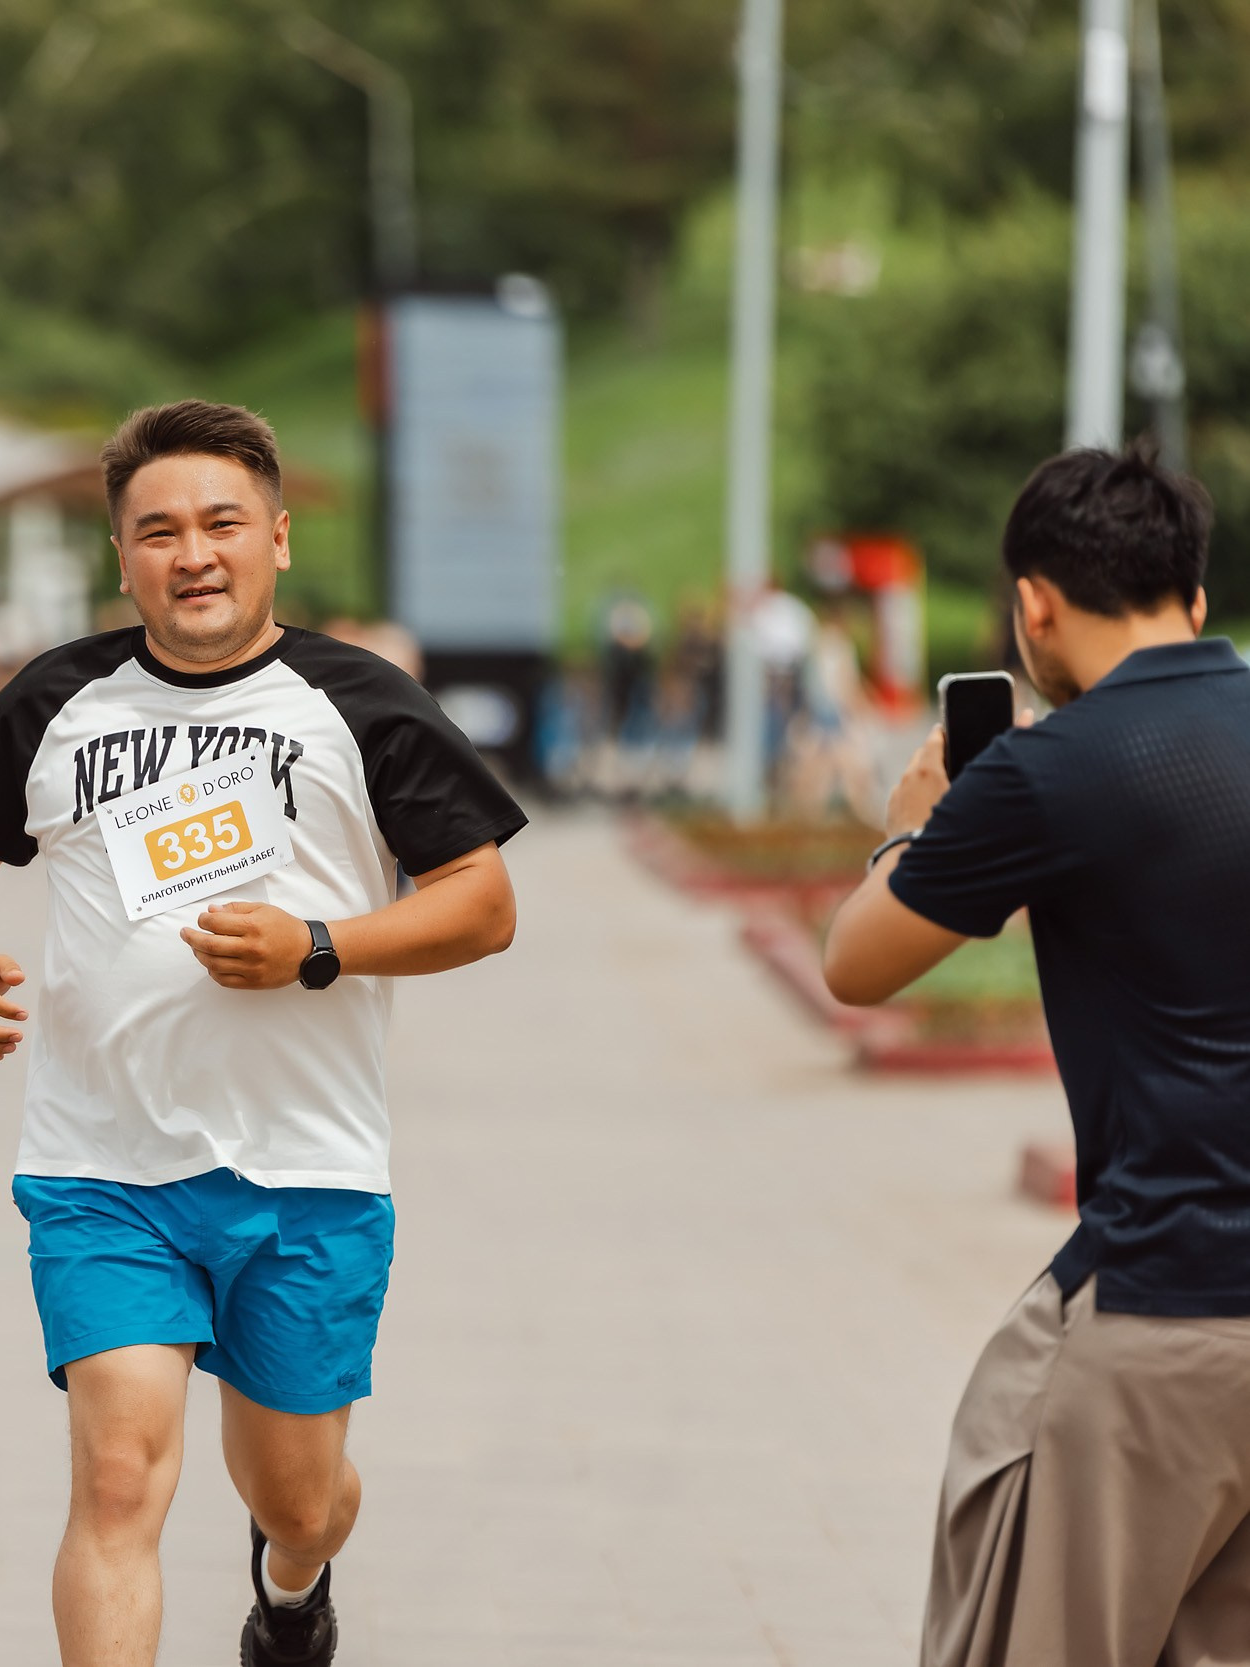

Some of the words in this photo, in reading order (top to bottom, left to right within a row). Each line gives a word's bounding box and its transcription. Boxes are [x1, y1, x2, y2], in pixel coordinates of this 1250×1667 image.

[72, 725, 177, 824] NEW
[114, 796, 174, 829] LEONE
[202, 766, 254, 796] D'ORO
[157, 810, 241, 870] 335
[141, 857, 249, 904] БЛАГОТВОРИТЕЛЬНЫЙ
[250, 846, 276, 866] ЗАБЕГ
